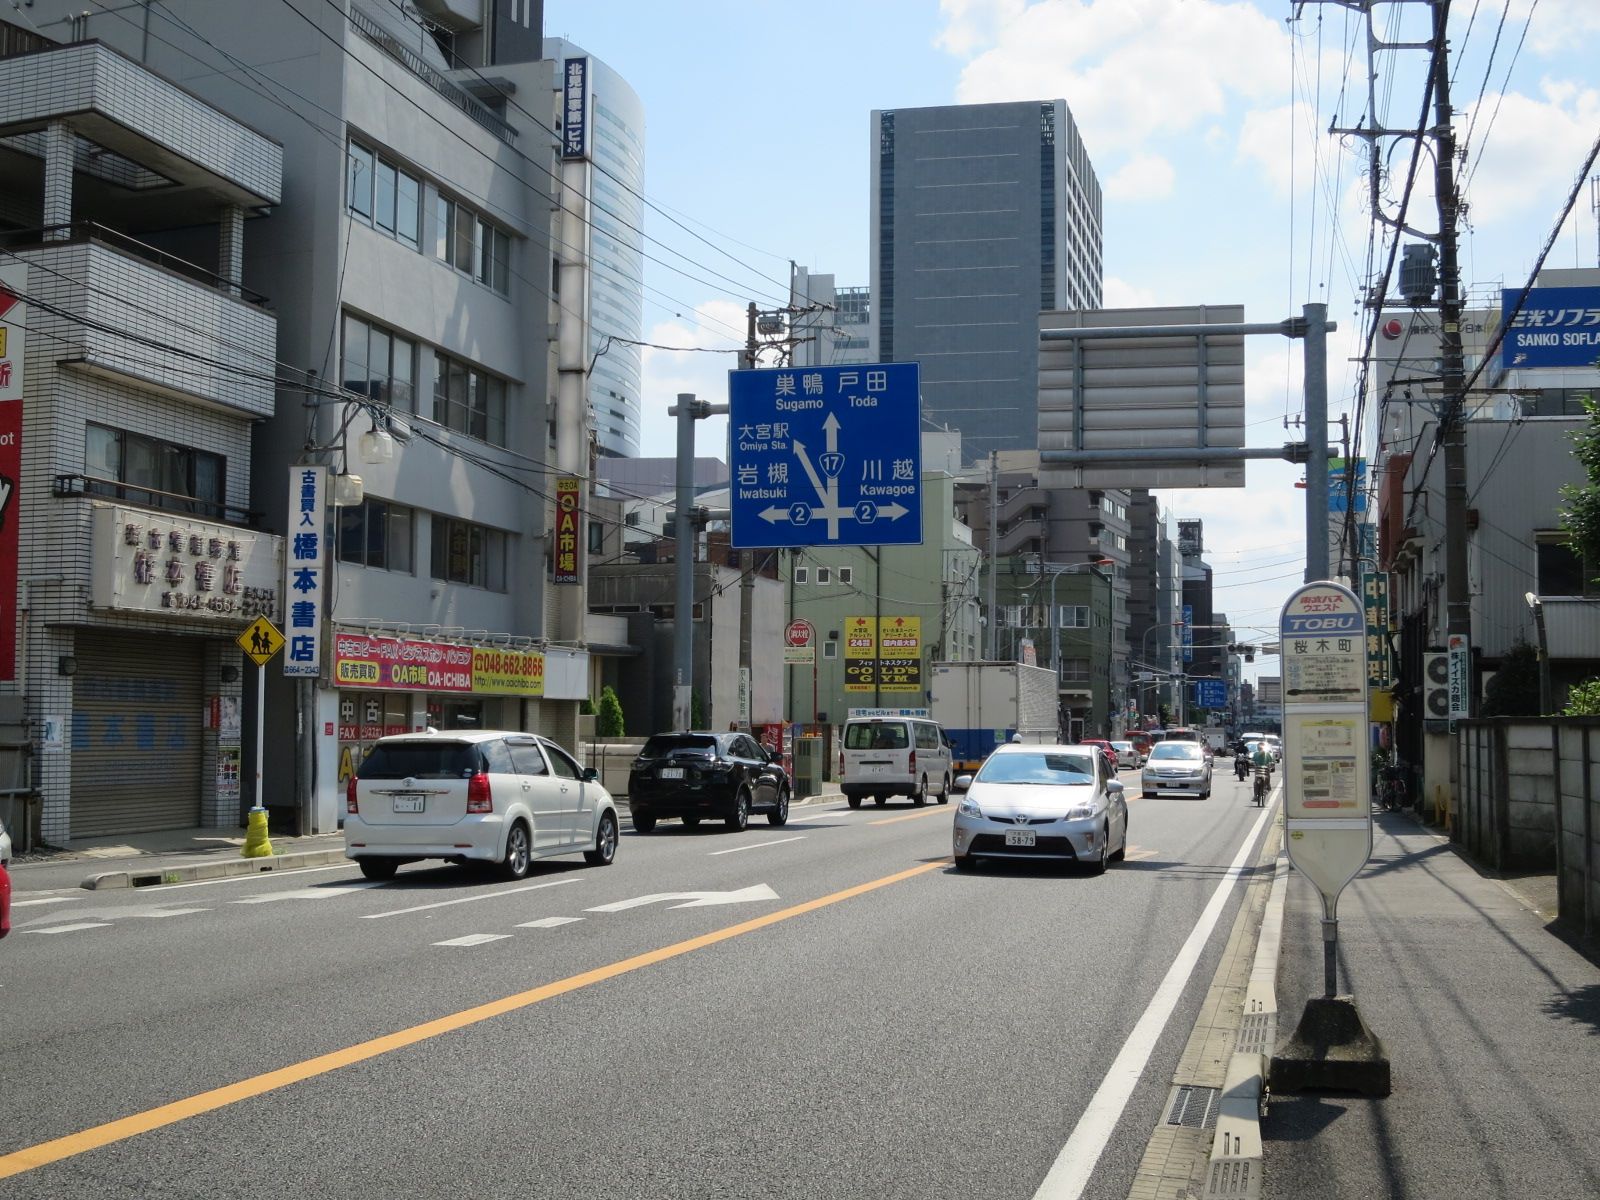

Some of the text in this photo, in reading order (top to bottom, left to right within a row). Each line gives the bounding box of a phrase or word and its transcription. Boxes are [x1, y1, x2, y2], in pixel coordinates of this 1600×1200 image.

[1517, 333, 1559, 347] SANKO
[775, 371, 887, 396] 巣鴨 戸田
[775, 396, 878, 412] Sugamo Toda
[738, 422, 790, 440] 大宮駅
[739, 441, 788, 452] Omiya Sta.
[823, 457, 838, 471] 17
[861, 458, 915, 482] 川越
[737, 462, 789, 485] 岩槻
[300, 470, 317, 527] 古書買入
[739, 487, 787, 499] Iwatsuki
[860, 484, 915, 497] Kawagoe
[795, 507, 805, 521] 2
[861, 505, 871, 519] 2
[559, 494, 575, 572] OA市場
[290, 533, 318, 662] 橋本書店
[1303, 604, 1340, 612] ウエスト
[1290, 617, 1354, 630] TOBU
[1294, 639, 1352, 654] 桜木町
[340, 662, 377, 679] 販売買取
[484, 655, 543, 677] 048-662-8866
[391, 664, 427, 685] OA市場
[341, 699, 378, 722] 中古
[339, 727, 356, 740] FAX
[338, 747, 354, 783] A
[1011, 836, 1034, 845] 58-79
